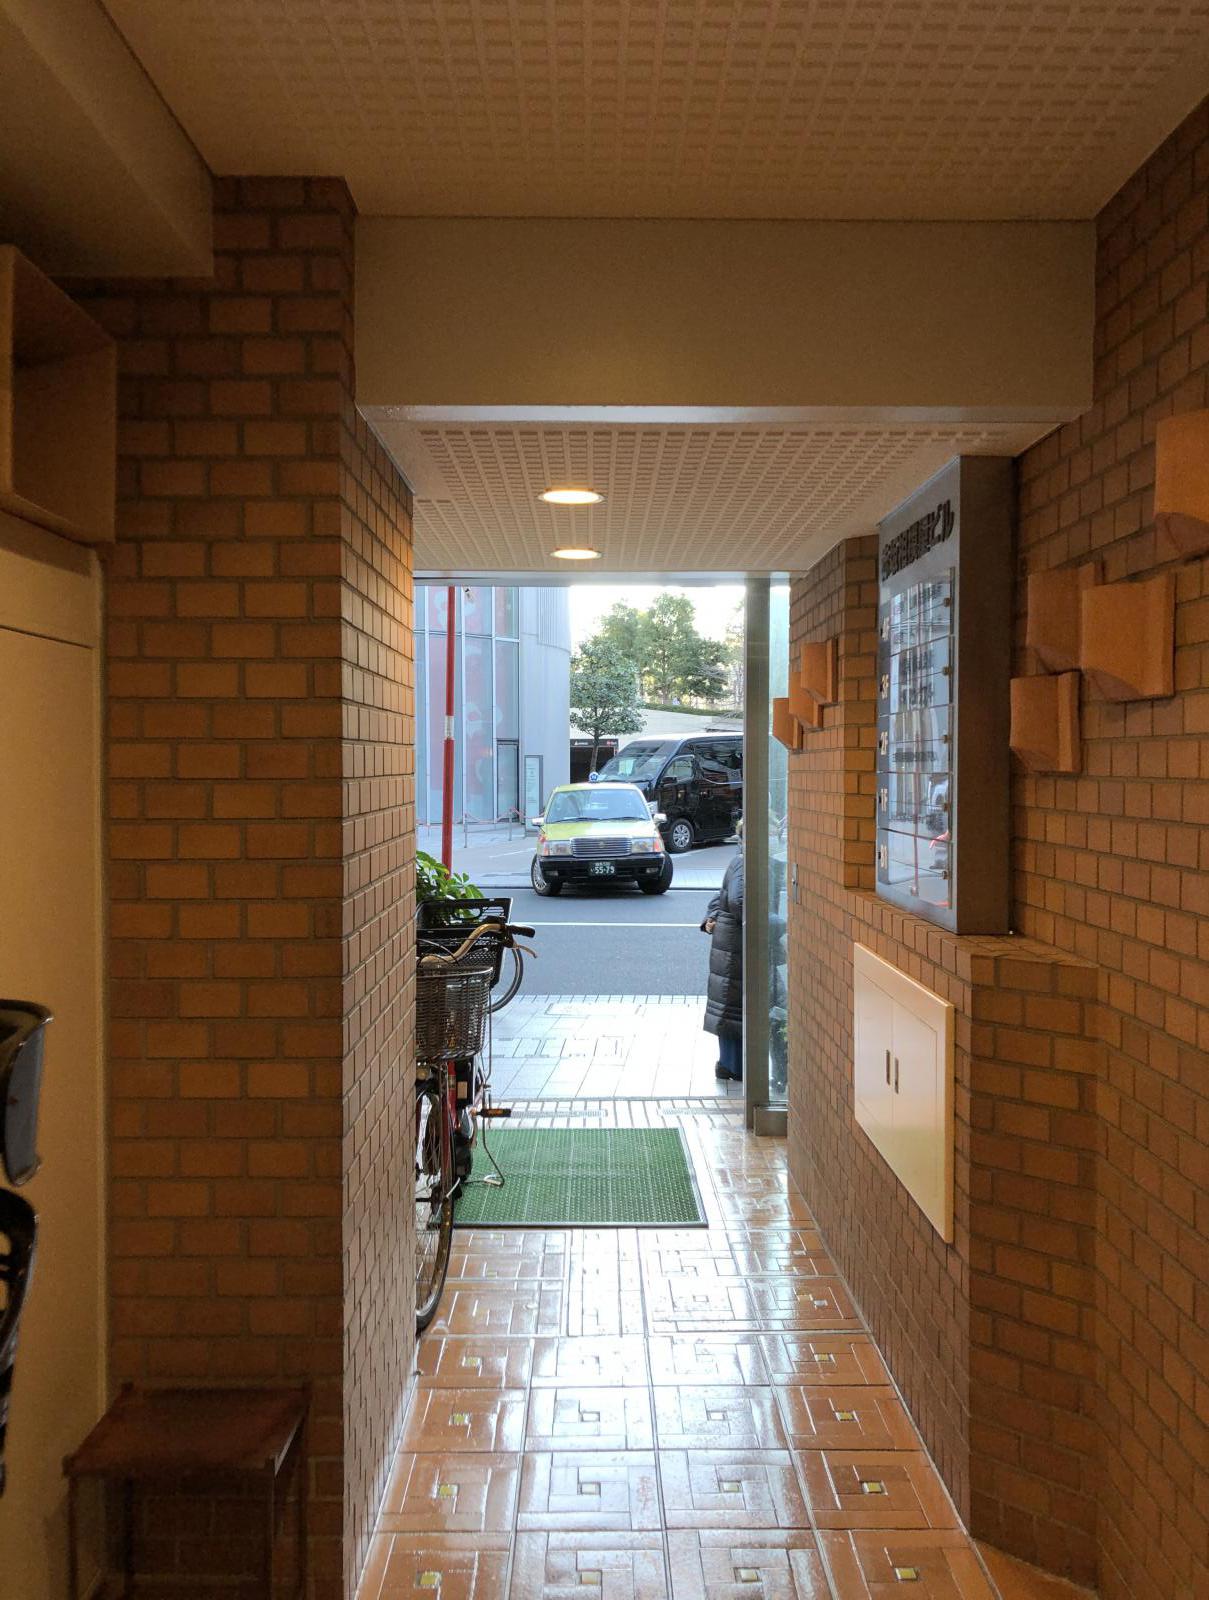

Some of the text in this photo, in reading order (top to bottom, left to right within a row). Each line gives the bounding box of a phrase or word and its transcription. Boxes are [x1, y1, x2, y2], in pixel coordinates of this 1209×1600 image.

[882, 616, 891, 641] 4F
[881, 673, 889, 700] 3F
[880, 731, 889, 755] 2F
[880, 788, 889, 812] 1F
